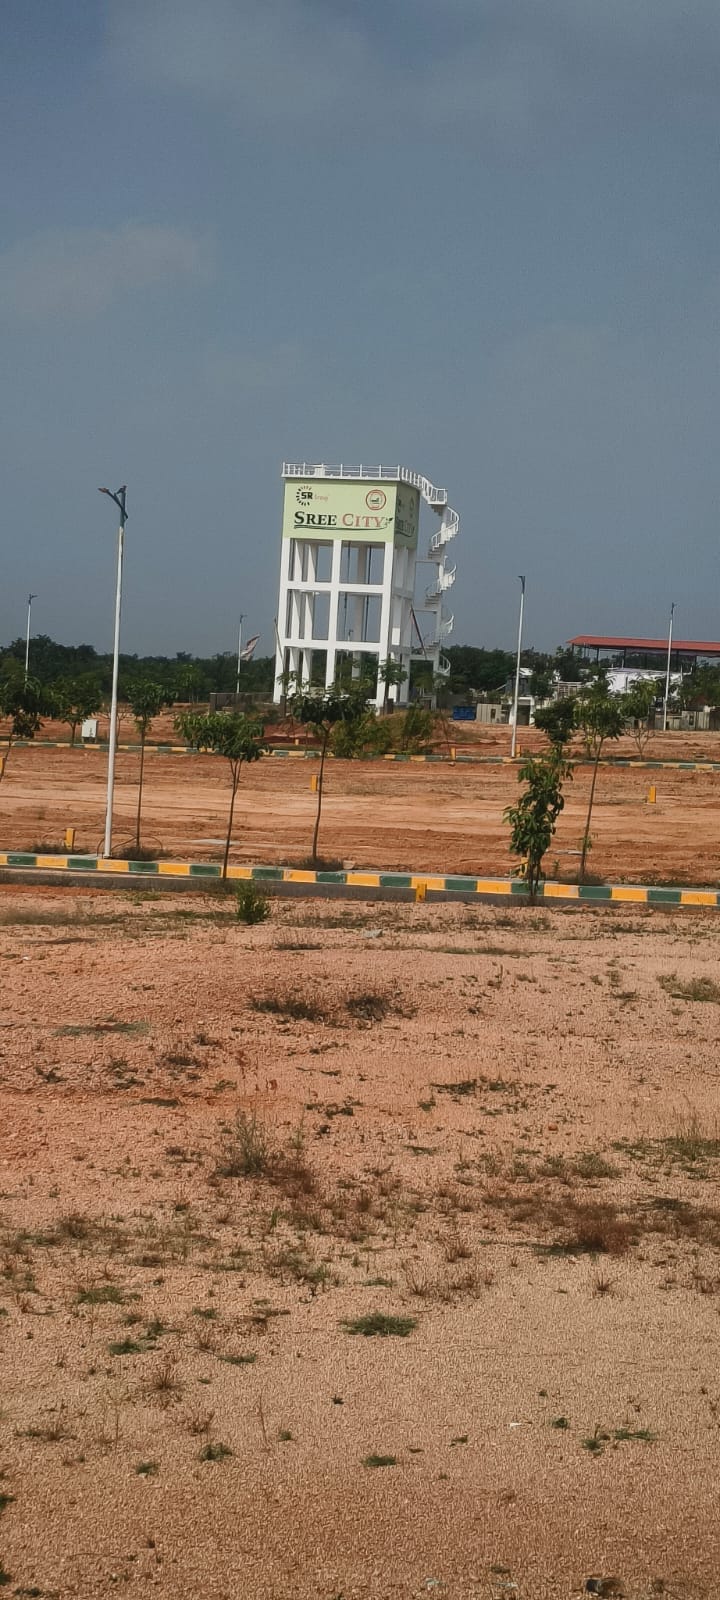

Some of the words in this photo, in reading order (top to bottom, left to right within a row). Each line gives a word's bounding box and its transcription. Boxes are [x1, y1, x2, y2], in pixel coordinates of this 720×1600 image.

[301, 491, 313, 500] SR
[294, 511, 337, 526] SREE
[342, 513, 385, 528] CITY
